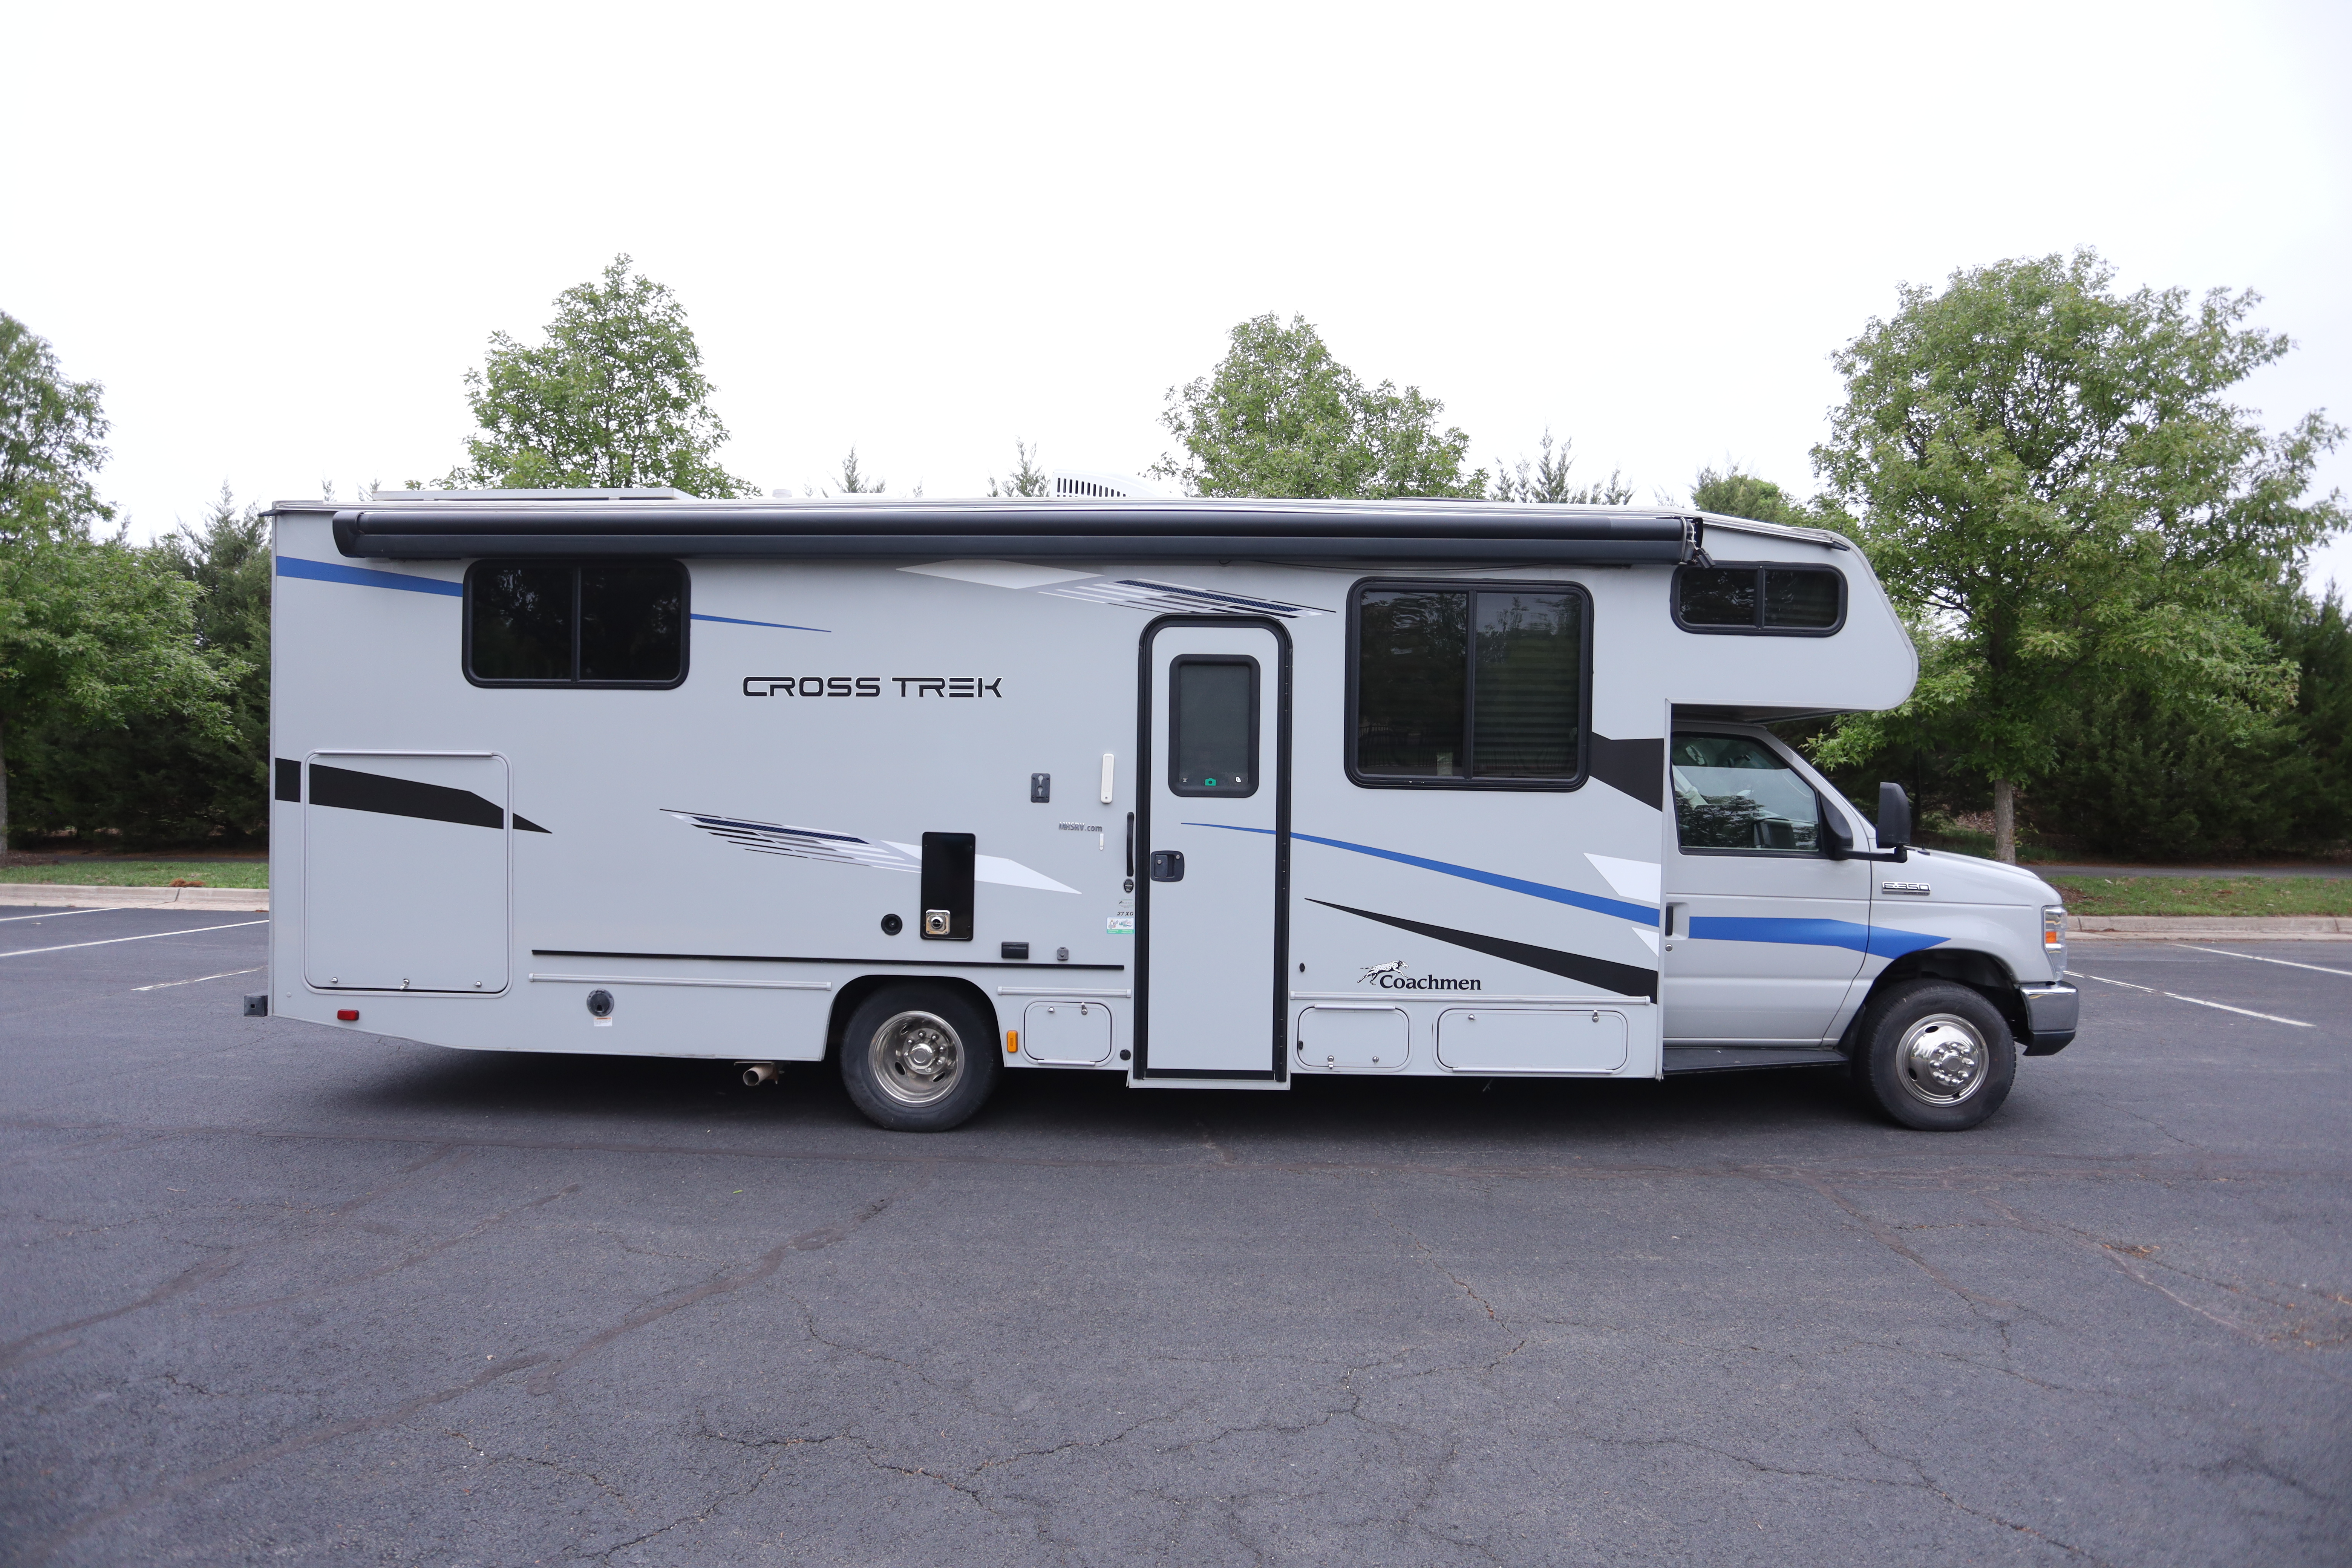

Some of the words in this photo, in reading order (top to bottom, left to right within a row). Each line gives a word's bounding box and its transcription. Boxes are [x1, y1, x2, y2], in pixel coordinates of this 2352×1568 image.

[743, 677, 880, 697] CROSS
[892, 677, 1003, 698] TREK
[1058, 821, 1102, 832] MHSRV.com
[1380, 974, 1482, 990] Coachmen
